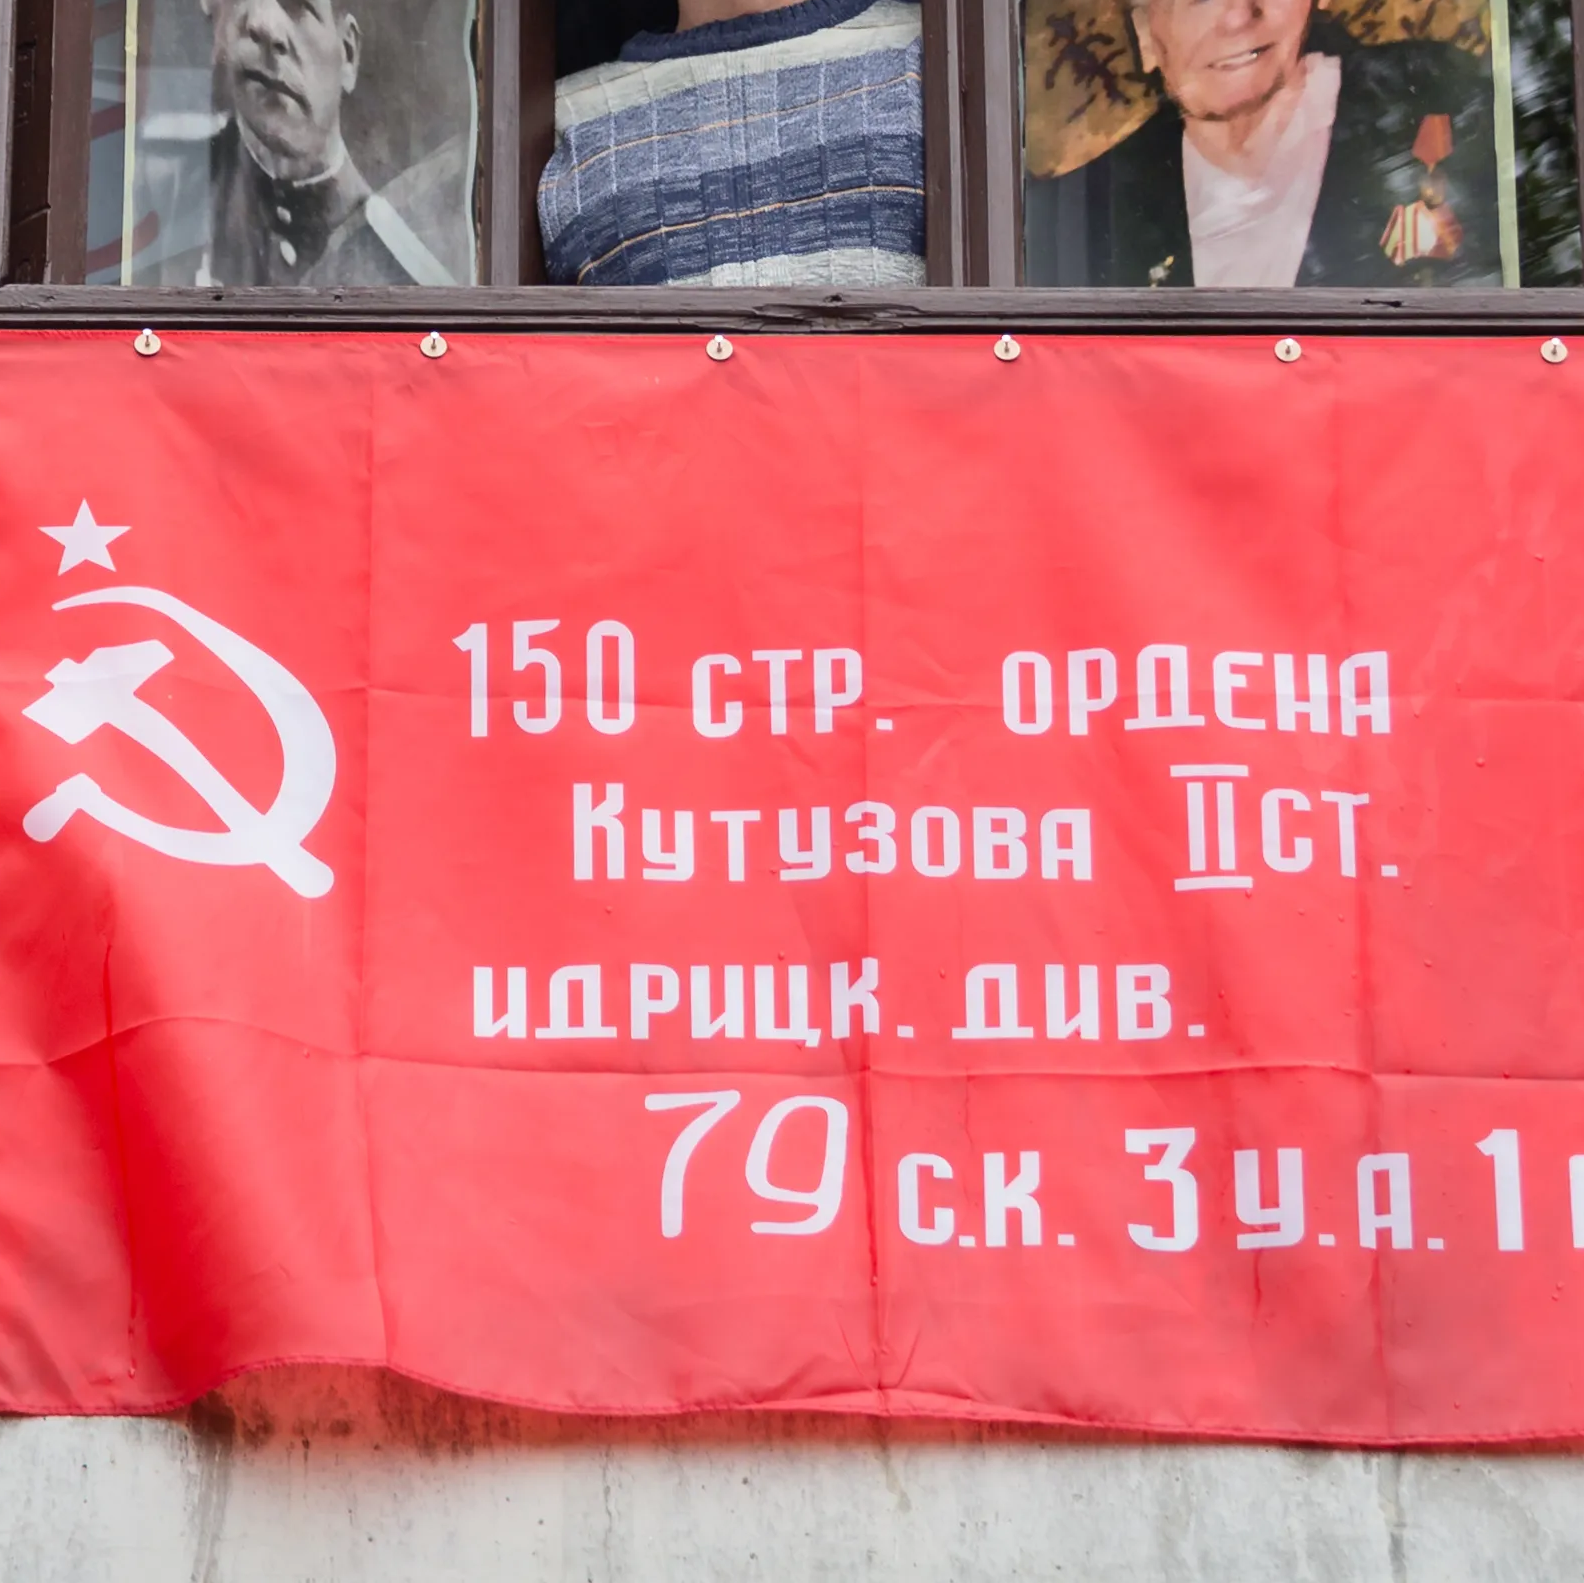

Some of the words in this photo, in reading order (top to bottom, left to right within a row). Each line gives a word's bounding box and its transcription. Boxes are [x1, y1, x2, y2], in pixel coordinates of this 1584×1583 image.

[451, 619, 636, 738] 150
[1001, 643, 1391, 738] ОРДЕНА
[644, 1089, 849, 1239] 79
